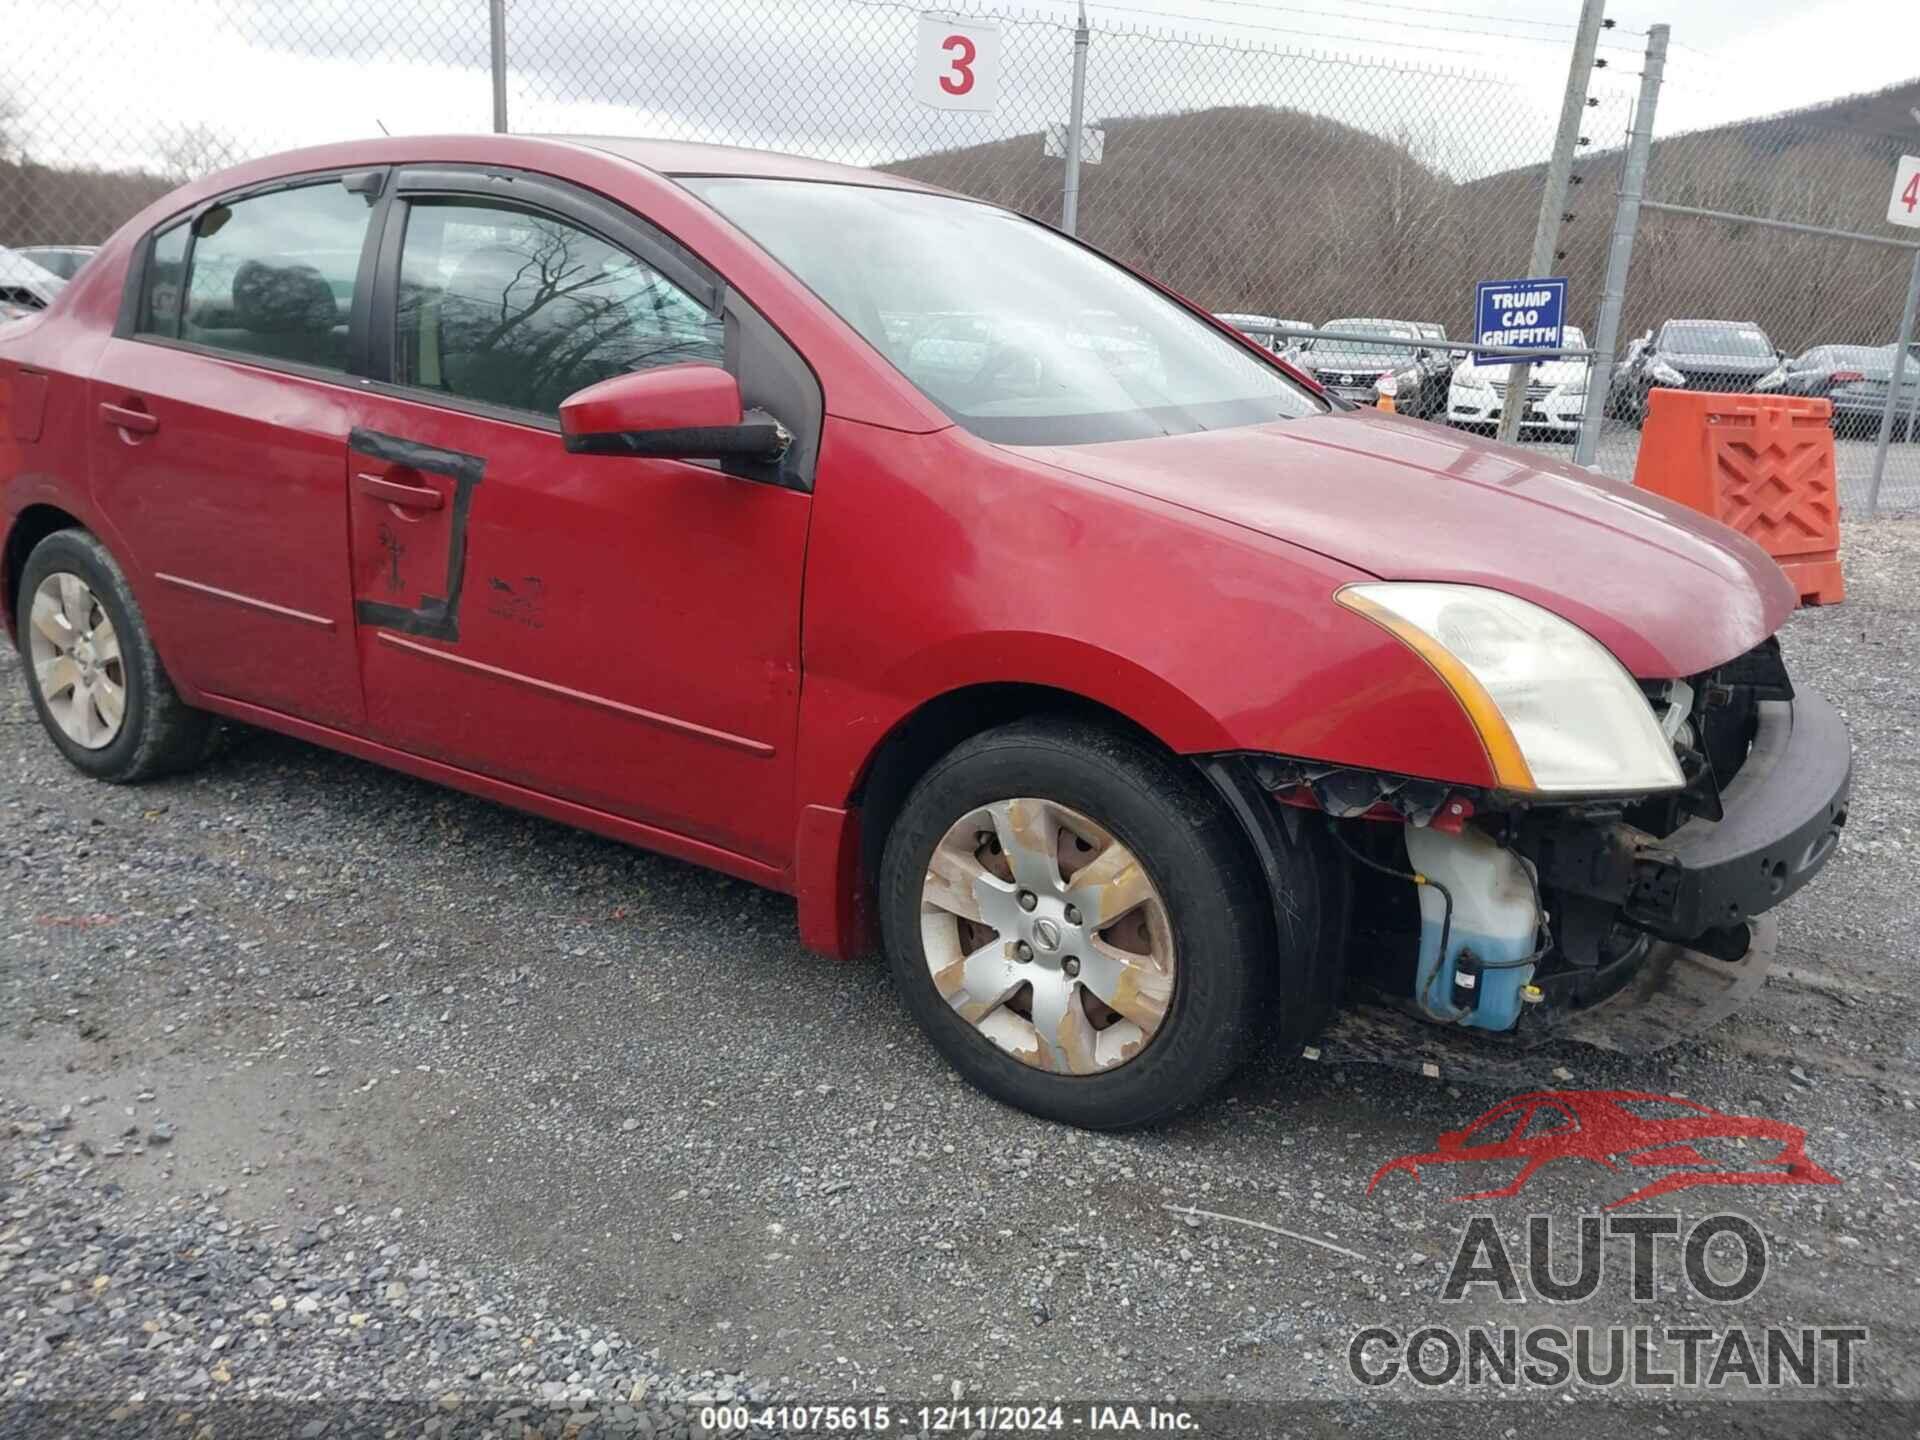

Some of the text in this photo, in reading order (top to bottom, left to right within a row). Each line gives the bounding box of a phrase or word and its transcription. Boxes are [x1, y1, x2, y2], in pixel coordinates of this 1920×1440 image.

[939, 35, 976, 95] 3
[1901, 173, 1920, 213] 4
[1492, 291, 1552, 309] TRUMP
[1502, 310, 1539, 327] CAO
[1482, 327, 1557, 345] GRIFFITH
